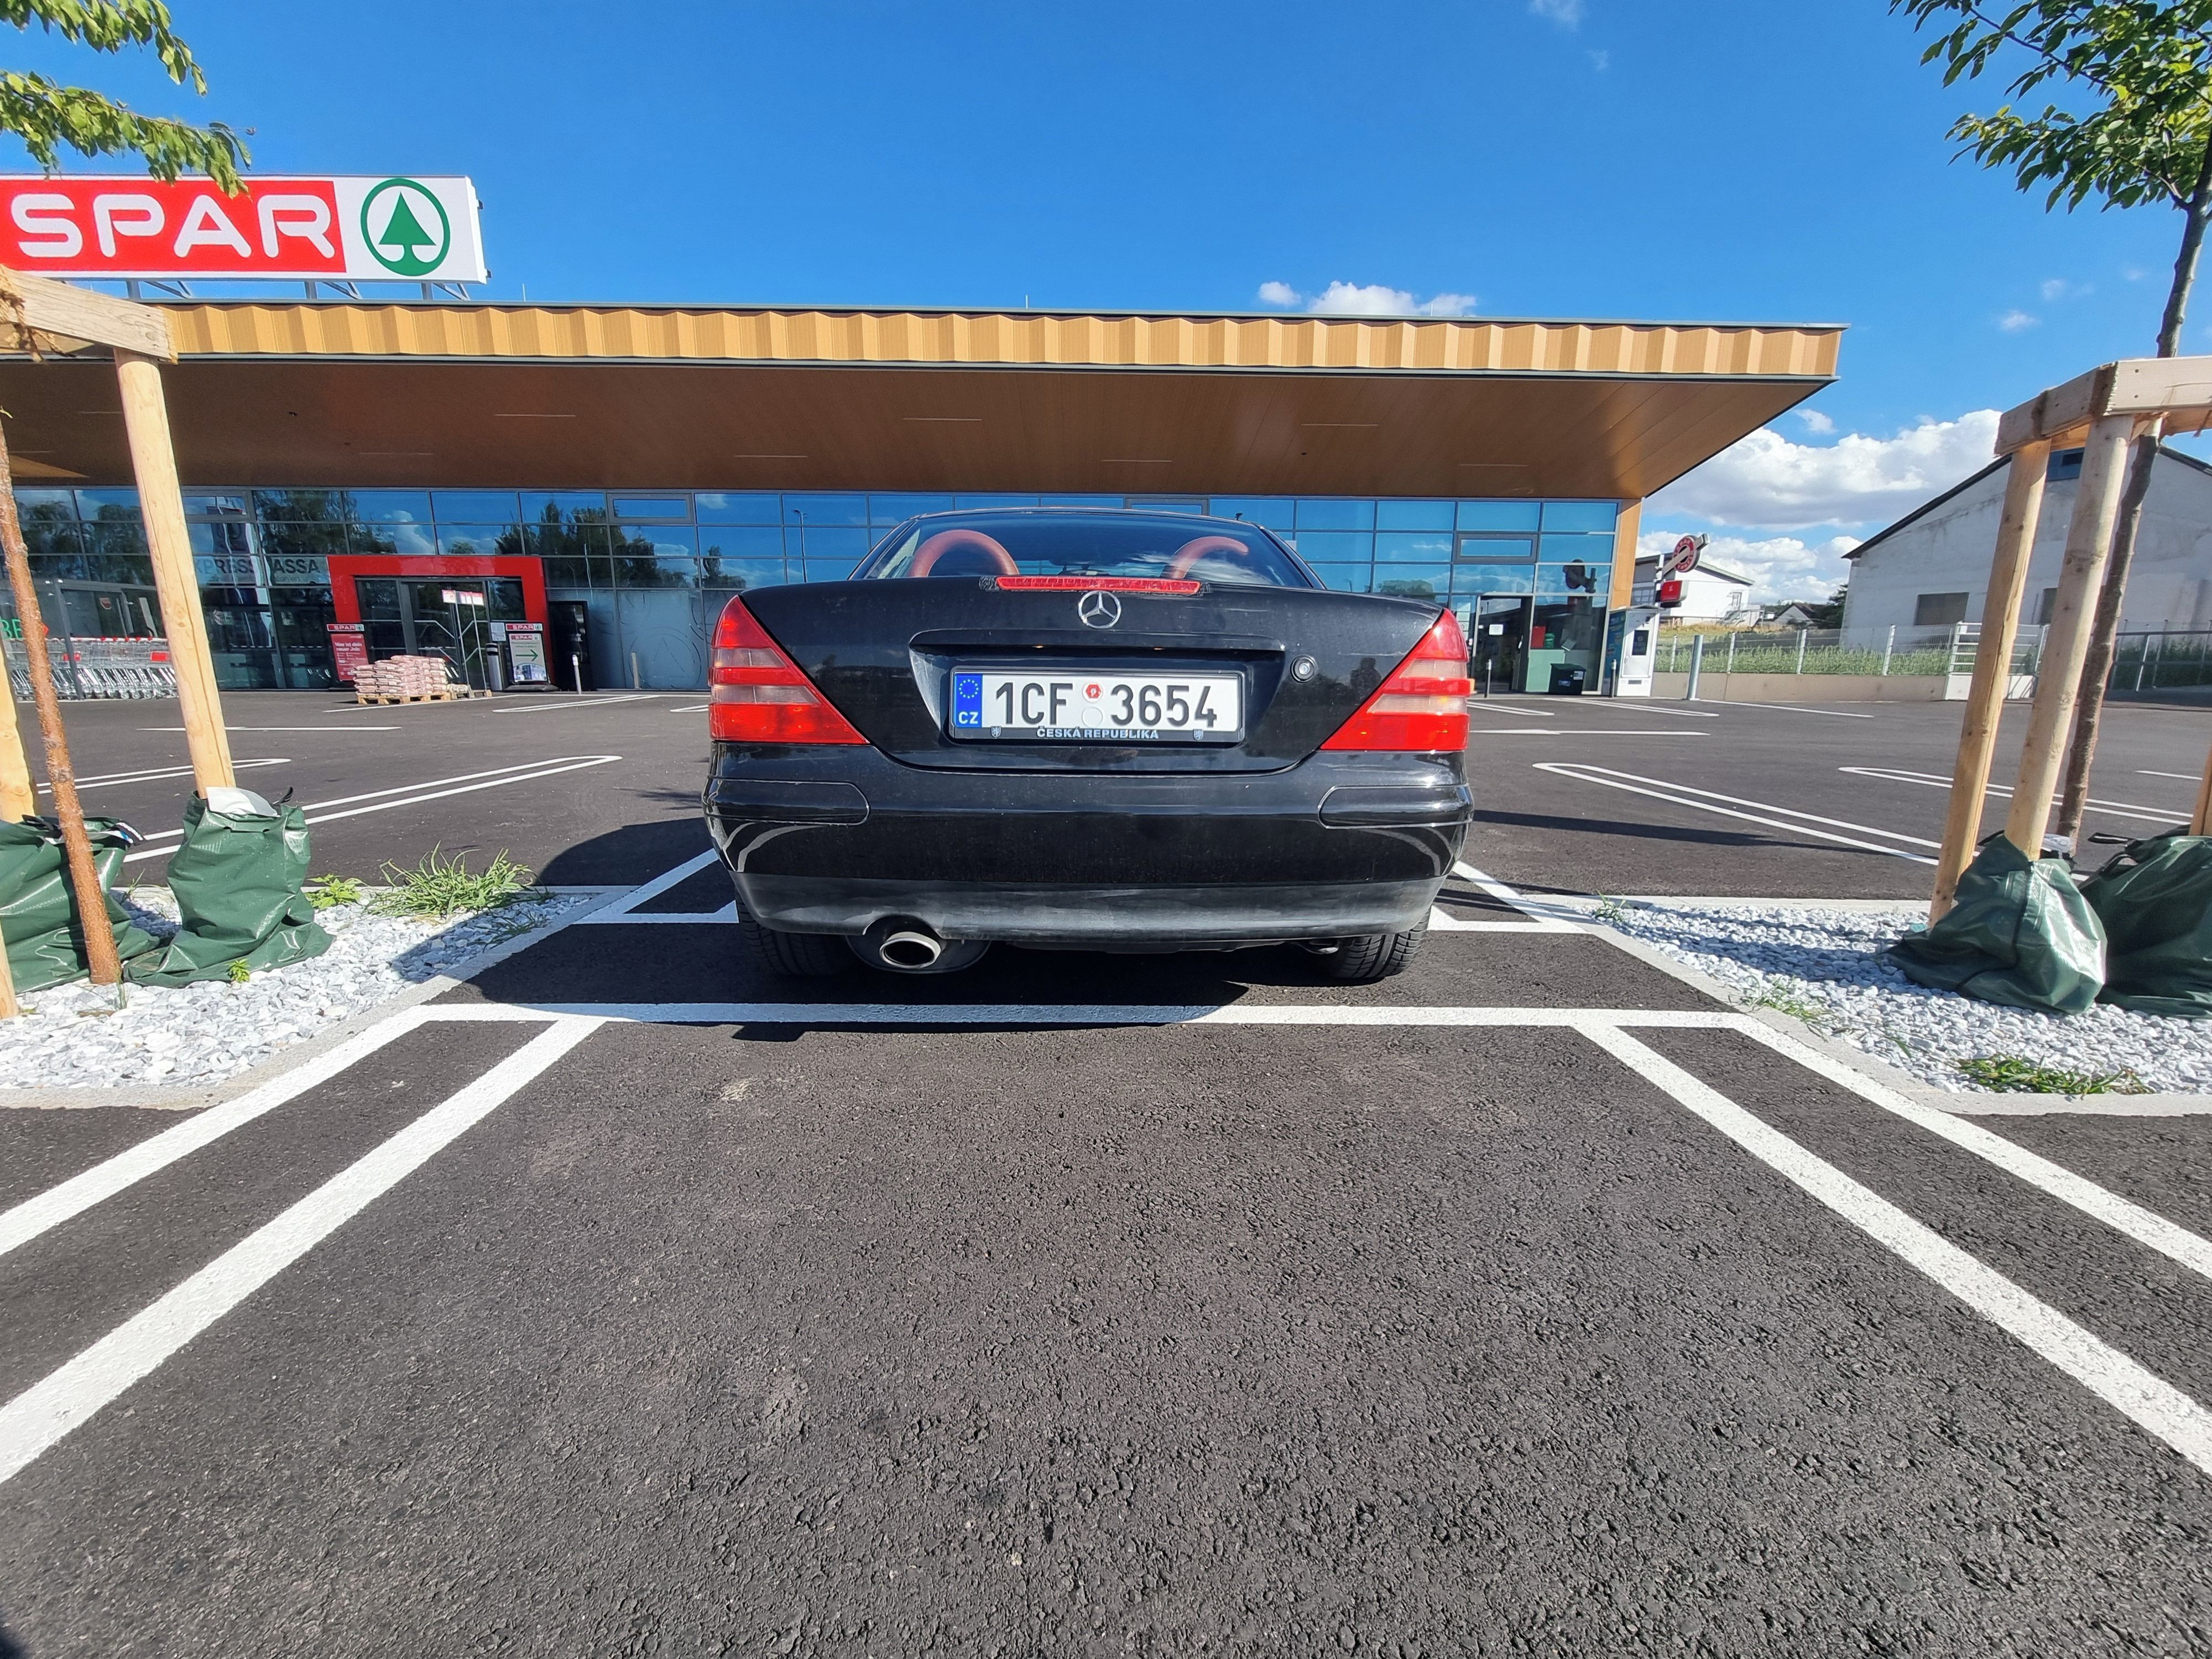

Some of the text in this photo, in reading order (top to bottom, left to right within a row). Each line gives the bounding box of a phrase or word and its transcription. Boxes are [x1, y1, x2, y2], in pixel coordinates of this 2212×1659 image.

[11, 194, 335, 258] SPAR
[958, 711, 979, 724] CZ
[996, 682, 1217, 728] 1CF 3654
[1036, 726, 1159, 740] ČESKÁ REPUBLIKA
